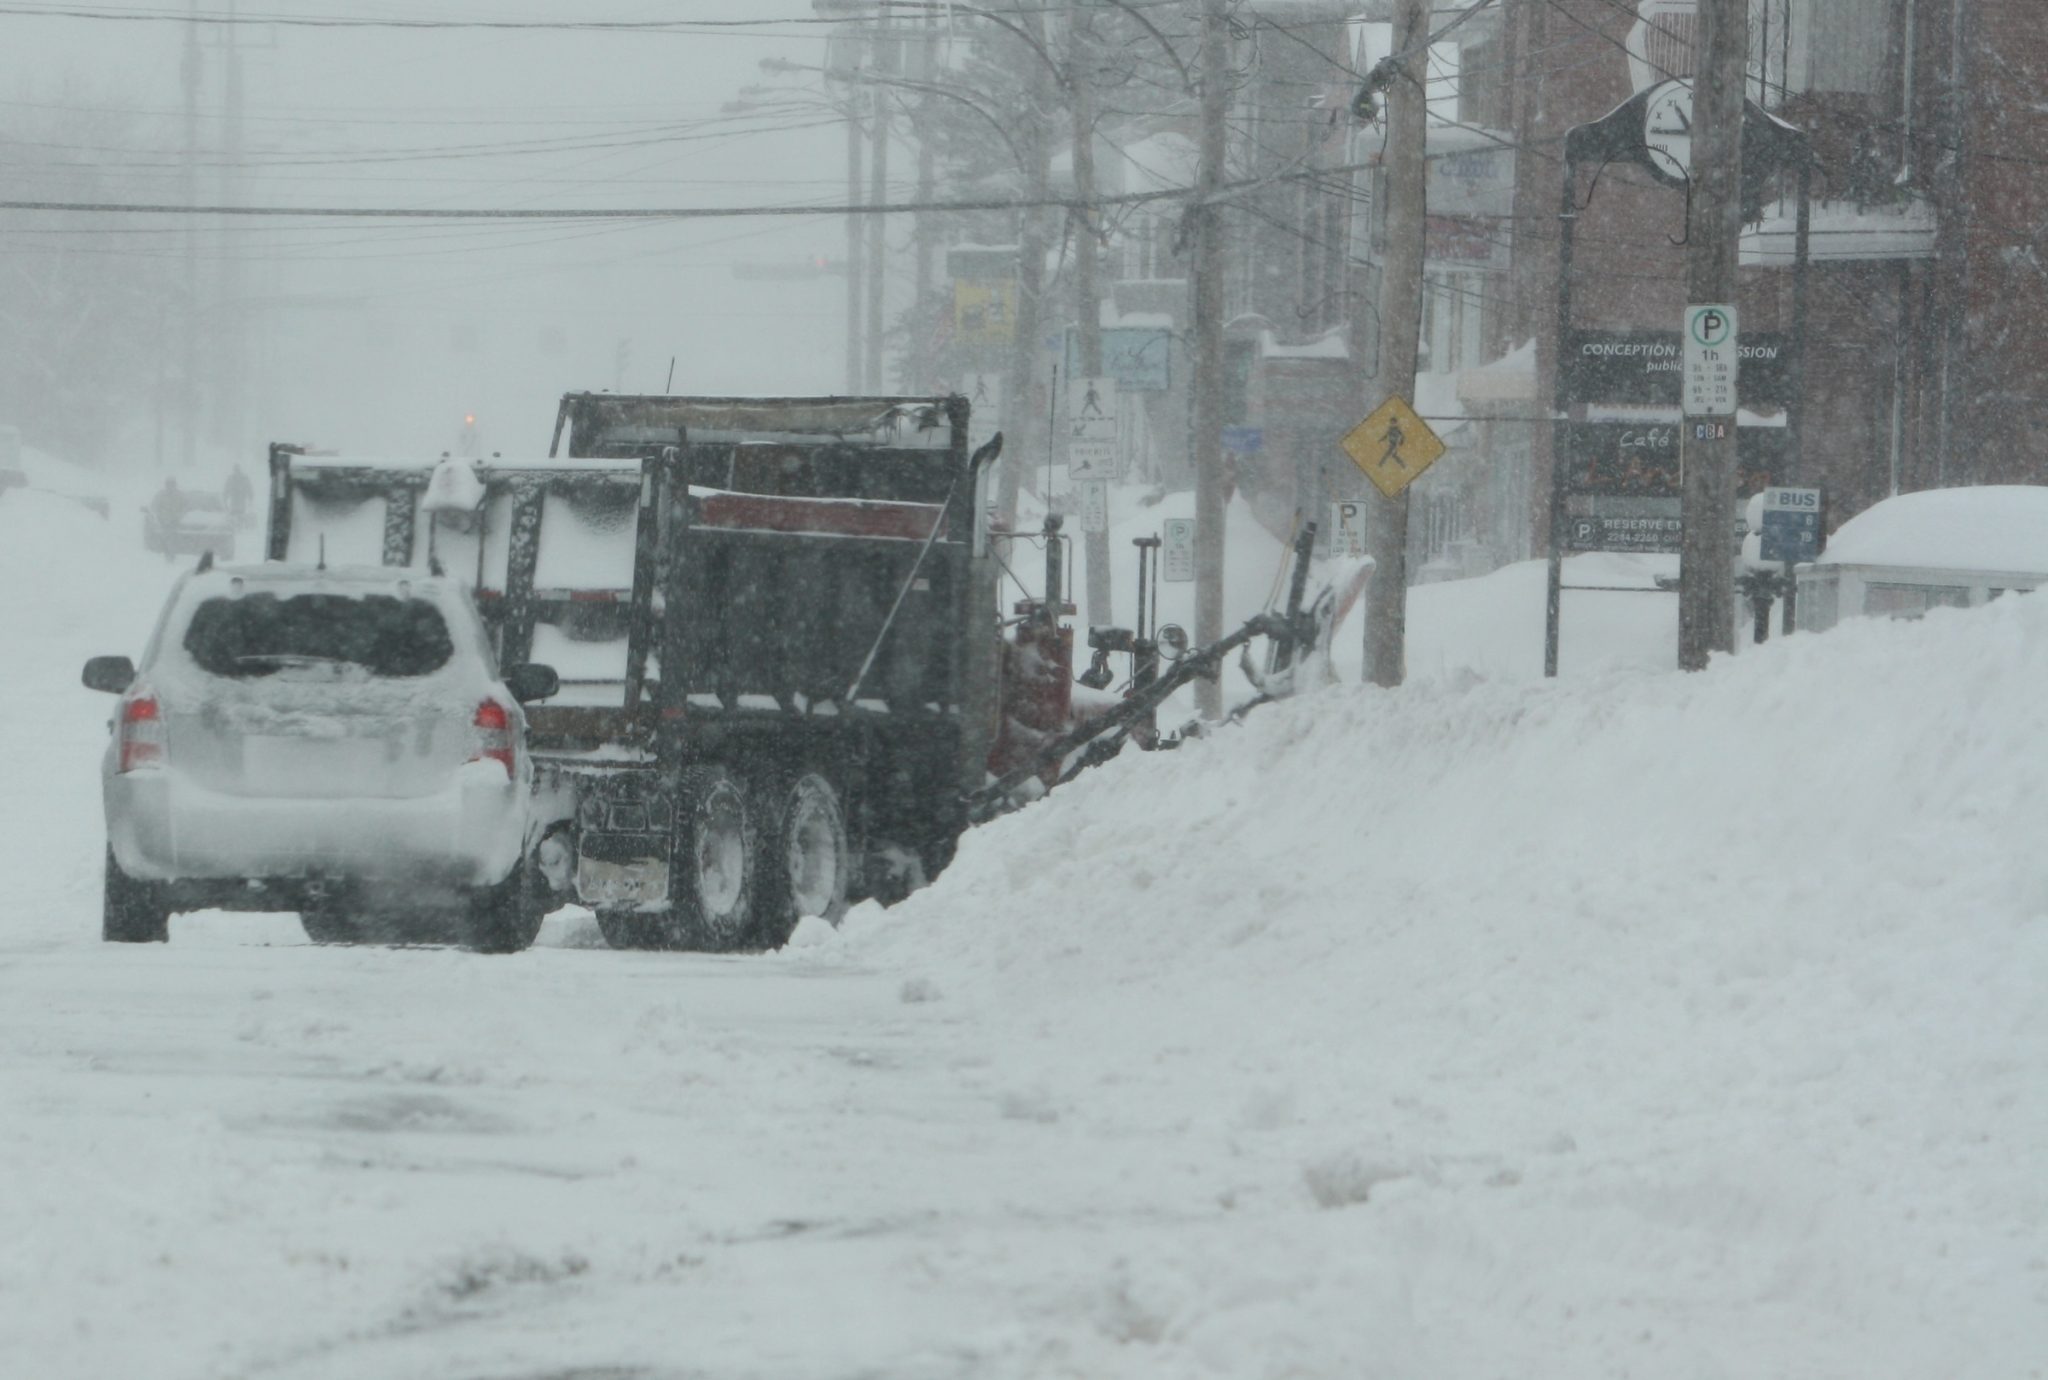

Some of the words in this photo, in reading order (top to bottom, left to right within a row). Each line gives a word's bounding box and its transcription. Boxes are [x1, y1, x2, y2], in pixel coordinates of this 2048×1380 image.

[1704, 314, 1721, 340] P
[1582, 343, 1676, 357] CONCEPTION
[1701, 350, 1719, 361] 1h
[1619, 428, 1671, 448] Café
[1779, 492, 1816, 507] BUS
[1340, 504, 1357, 529] P
[1578, 523, 1592, 539] P
